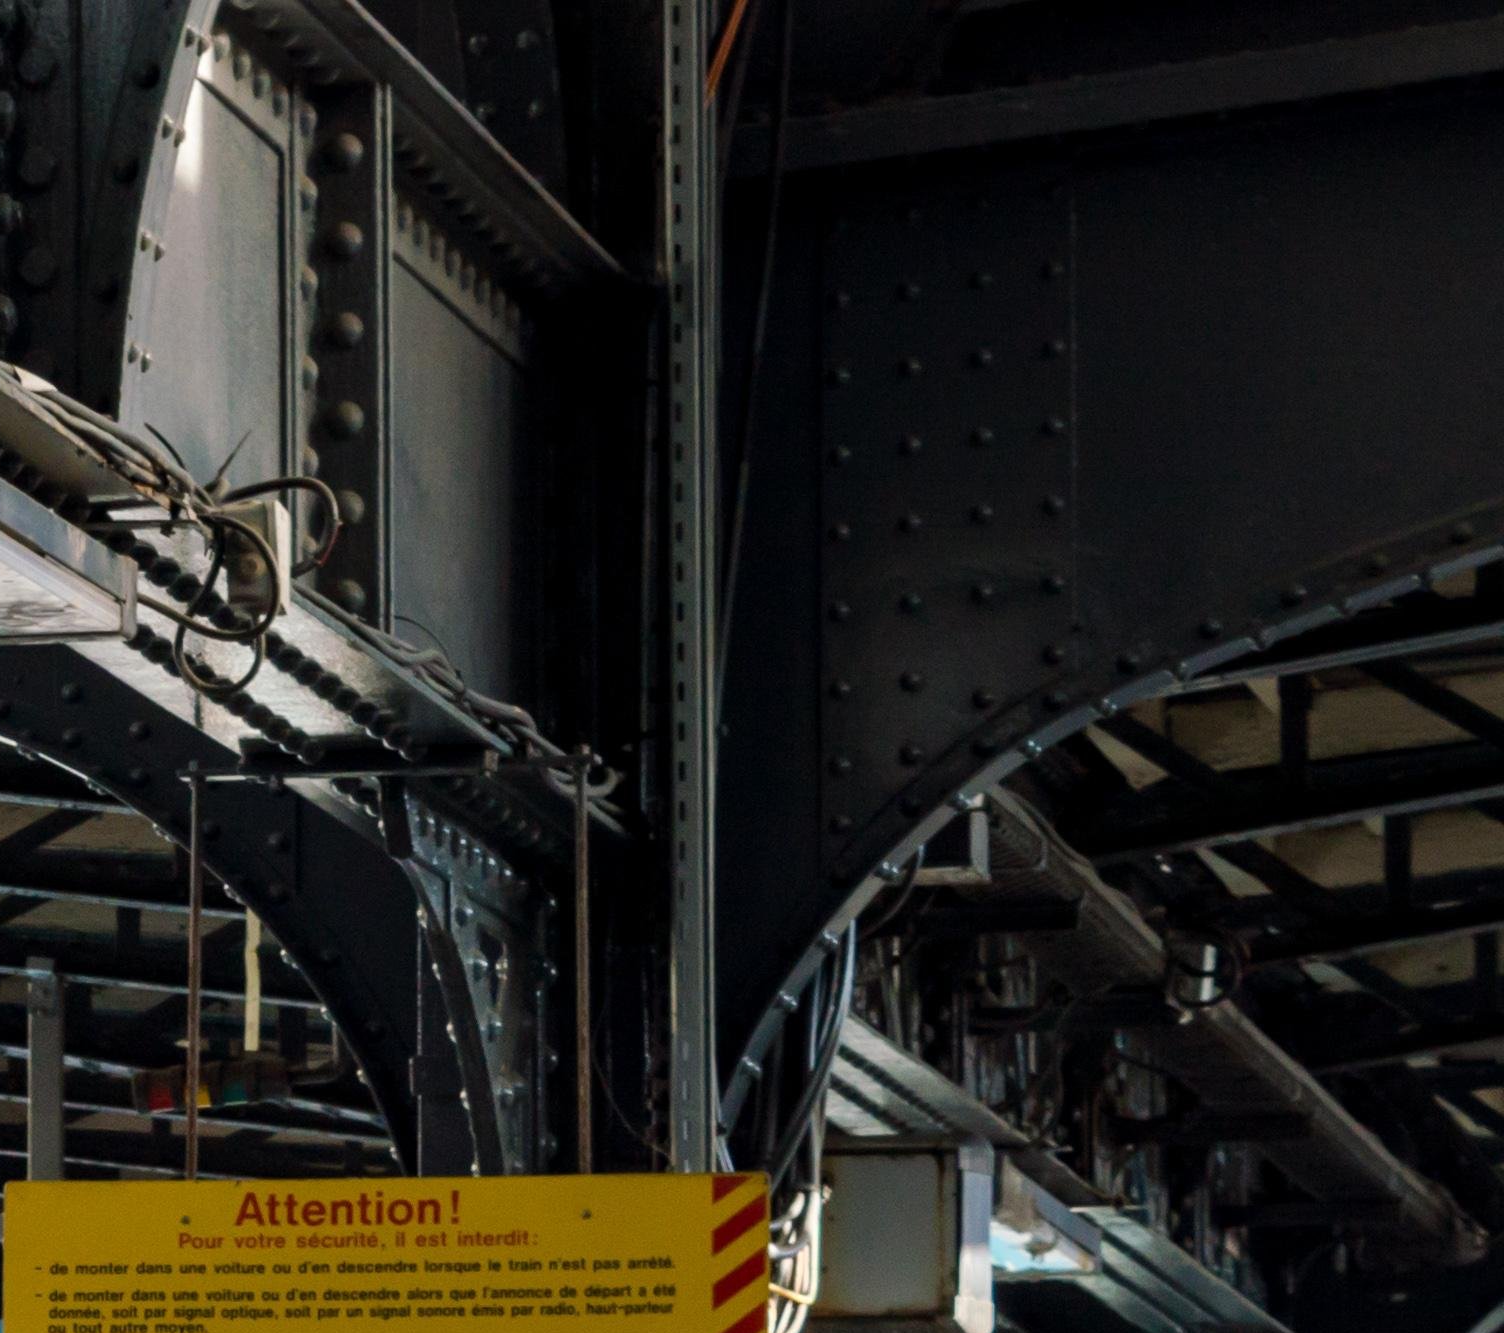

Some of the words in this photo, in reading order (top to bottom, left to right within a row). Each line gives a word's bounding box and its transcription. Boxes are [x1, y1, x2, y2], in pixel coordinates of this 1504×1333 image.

[178, 1232, 224, 1250] Pour
[234, 1232, 286, 1249] votre
[395, 1231, 406, 1247] il
[415, 1231, 447, 1247] est
[49, 1263, 68, 1276] de
[75, 1262, 129, 1275] monter
[136, 1262, 172, 1274] dans
[179, 1264, 207, 1275] une
[214, 1263, 266, 1275] voiture
[272, 1264, 291, 1274] ou
[336, 1261, 418, 1274] descendre
[424, 1260, 481, 1274] lorsque
[488, 1260, 502, 1272] le
[508, 1260, 542, 1272] train
[593, 1260, 621, 1272] pas
[48, 1290, 67, 1303] de
[73, 1291, 124, 1303] monter
[131, 1289, 166, 1302] dans
[172, 1291, 199, 1301] une
[205, 1289, 255, 1302] voiture
[261, 1291, 280, 1301] ou
[323, 1288, 400, 1302] descendre
[407, 1287, 443, 1300] alors
[449, 1289, 477, 1302] que
[559, 1285, 577, 1298] de
[638, 1287, 647, 1298] a
[653, 1285, 676, 1297] été
[144, 1308, 167, 1320] par
[174, 1306, 215, 1322] signal
[317, 1308, 340, 1320] par
[346, 1308, 363, 1318] un
[369, 1305, 411, 1320] signal
[416, 1301, 466, 1317] sonore
[511, 1306, 534, 1318] par
[110, 1322, 148, 1333] autre
